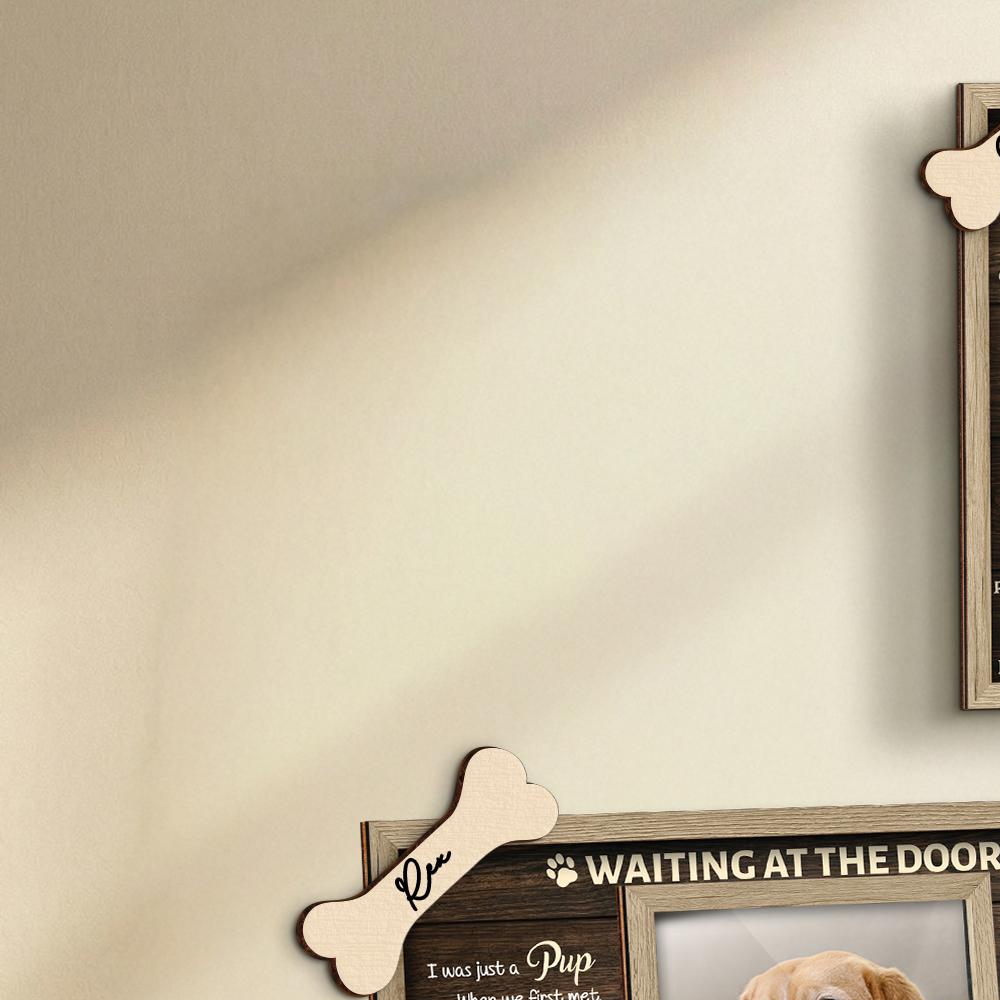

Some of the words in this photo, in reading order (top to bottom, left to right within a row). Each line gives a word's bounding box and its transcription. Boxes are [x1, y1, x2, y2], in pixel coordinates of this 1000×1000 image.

[395, 851, 451, 911] Rex
[585, 850, 755, 885] WAITING
[763, 849, 807, 878] AT
[814, 846, 889, 876] THE
